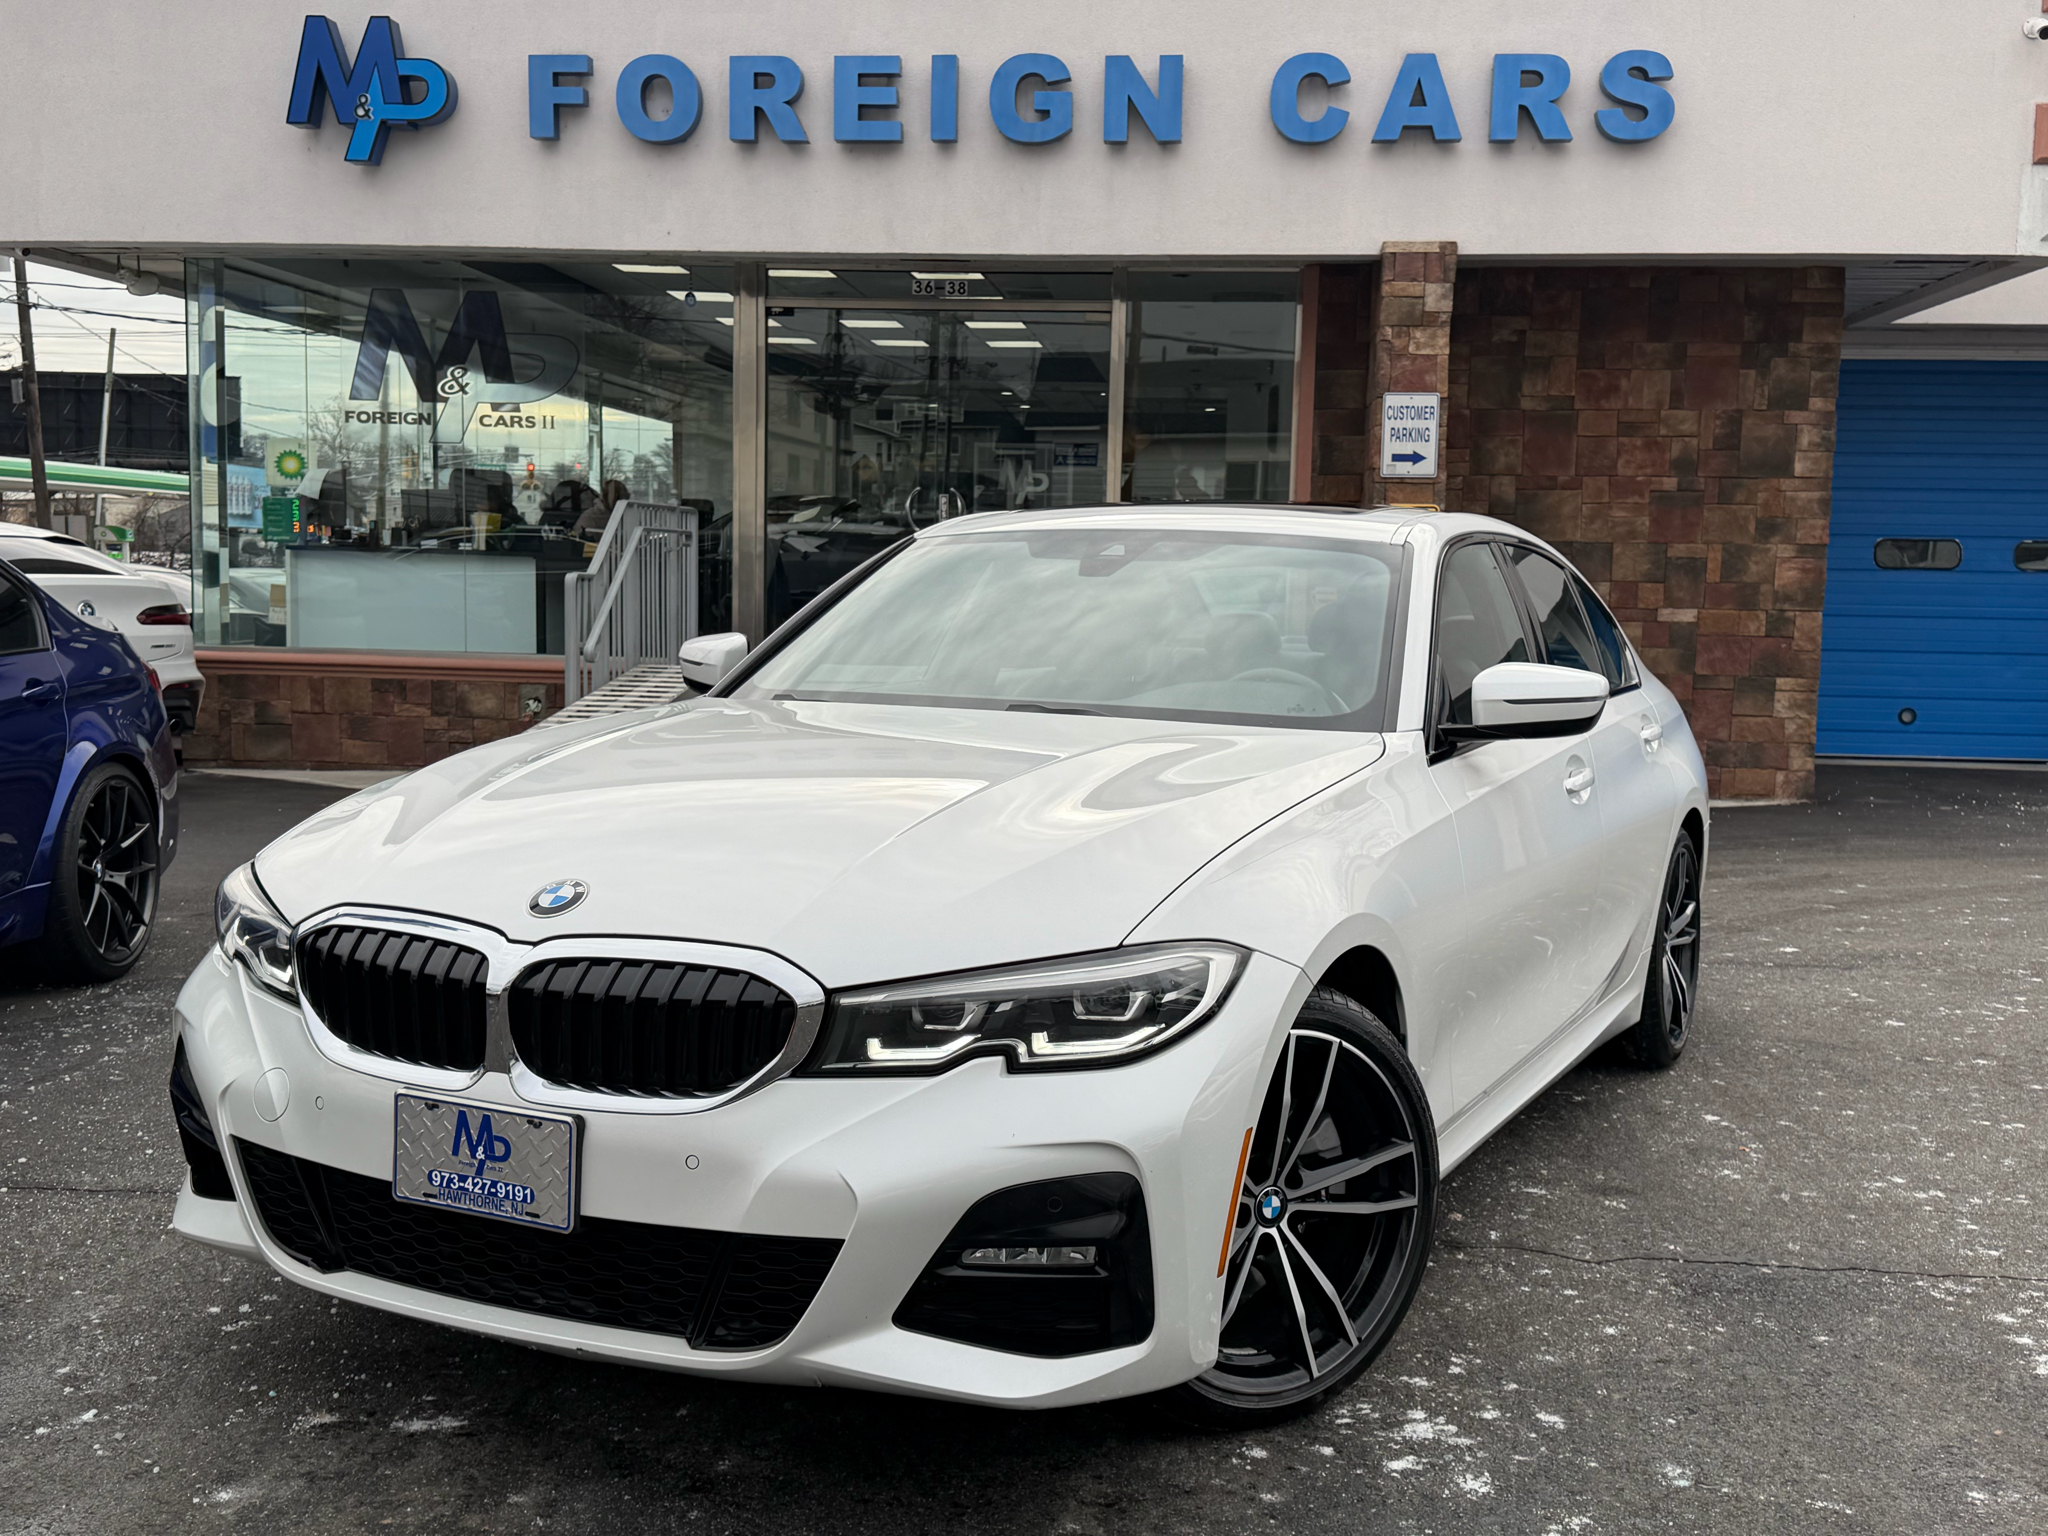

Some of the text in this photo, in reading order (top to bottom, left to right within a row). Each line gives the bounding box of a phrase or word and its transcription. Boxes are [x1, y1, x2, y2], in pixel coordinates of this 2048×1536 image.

[528, 53, 1184, 146] FOREIGN
[1270, 49, 1677, 146] CARS
[914, 280, 967, 295] 36-38
[344, 410, 556, 430] FOREIGN CARS II
[1386, 405, 1435, 421] CUSTOMER
[1389, 427, 1431, 443] PARKING
[431, 1170, 532, 1204] 973-427-9191
[438, 1189, 525, 1216] HAWTHORNE, NJ
